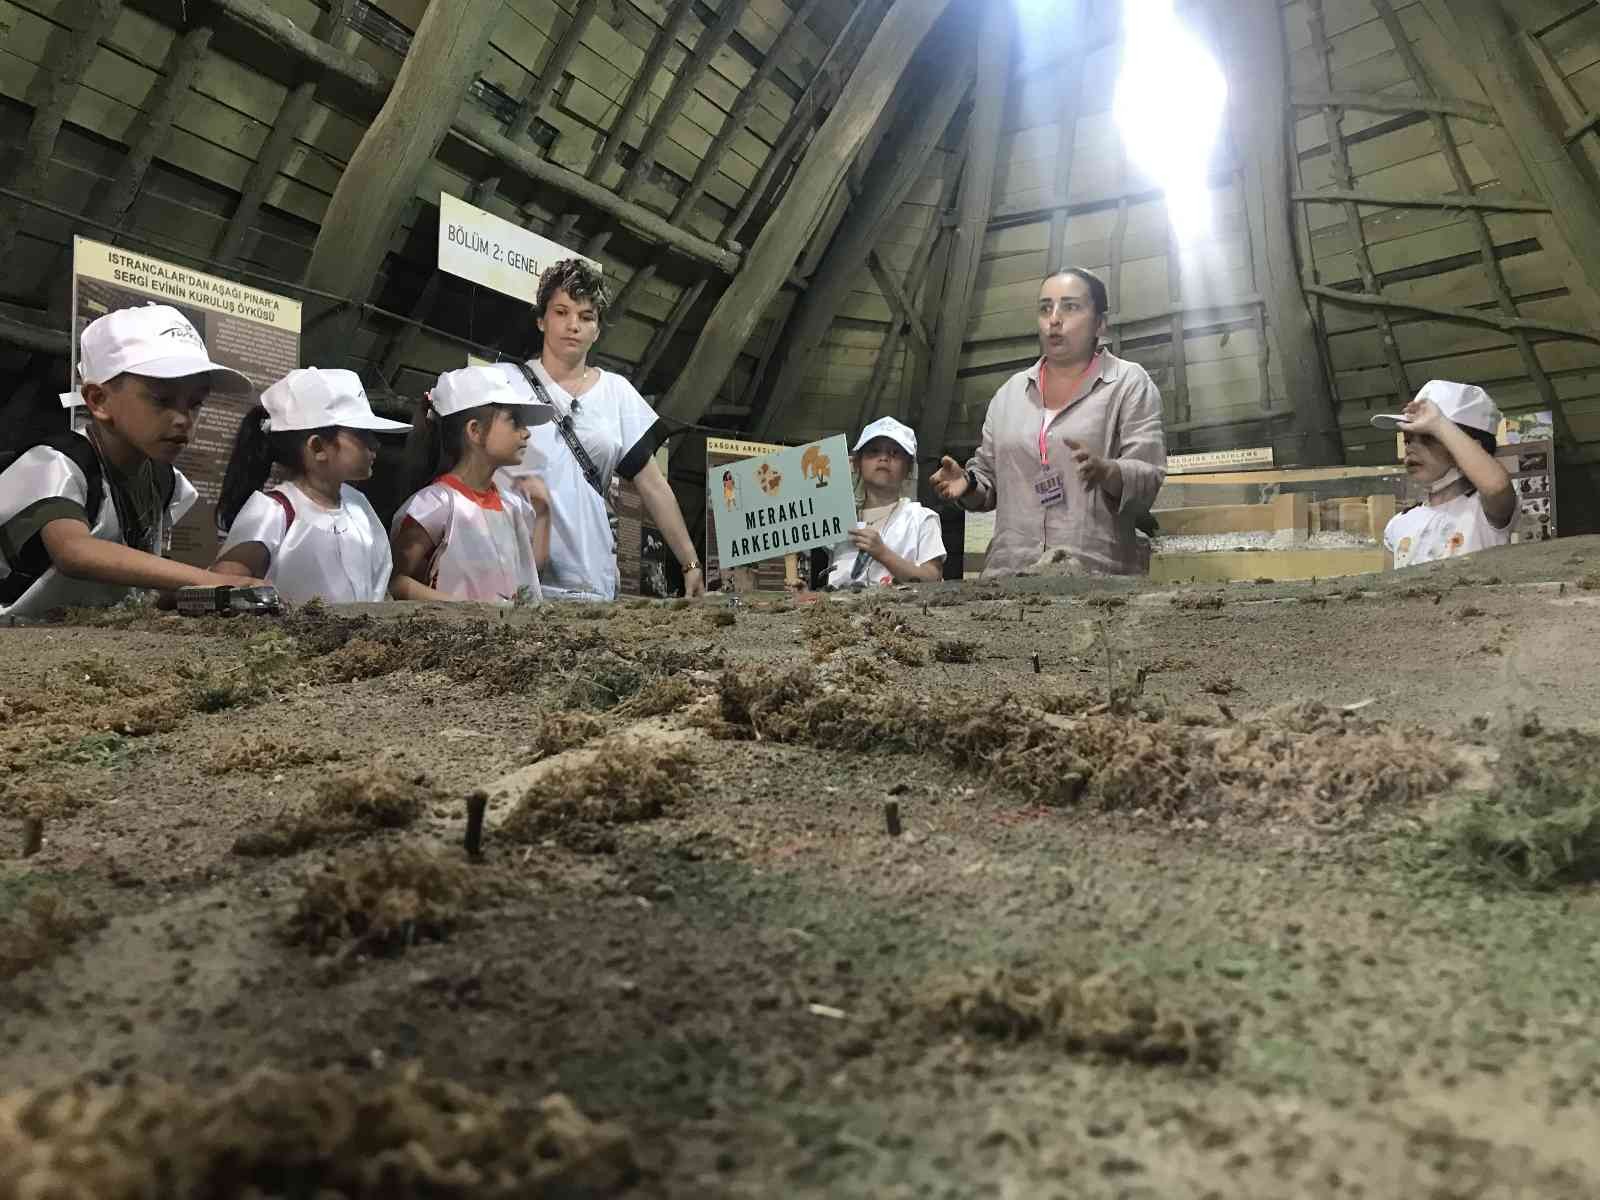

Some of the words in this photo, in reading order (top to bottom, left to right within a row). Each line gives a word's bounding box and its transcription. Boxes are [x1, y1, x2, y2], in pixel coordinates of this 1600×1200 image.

[448, 224, 489, 256] BÖLÜM
[493, 243, 504, 263] 2:
[507, 250, 540, 277] GENEL
[113, 269, 149, 288] SERGİ
[151, 279, 186, 298] EVİNİN
[189, 290, 235, 313] KURULUŞ
[237, 303, 276, 322] ÖYKÜSÜ
[212, 284, 241, 301] AŞAĞI
[244, 292, 280, 311] PINAR'A
[745, 497, 815, 530] MERAKLI
[731, 516, 842, 558] ARKEOLOGLAR
